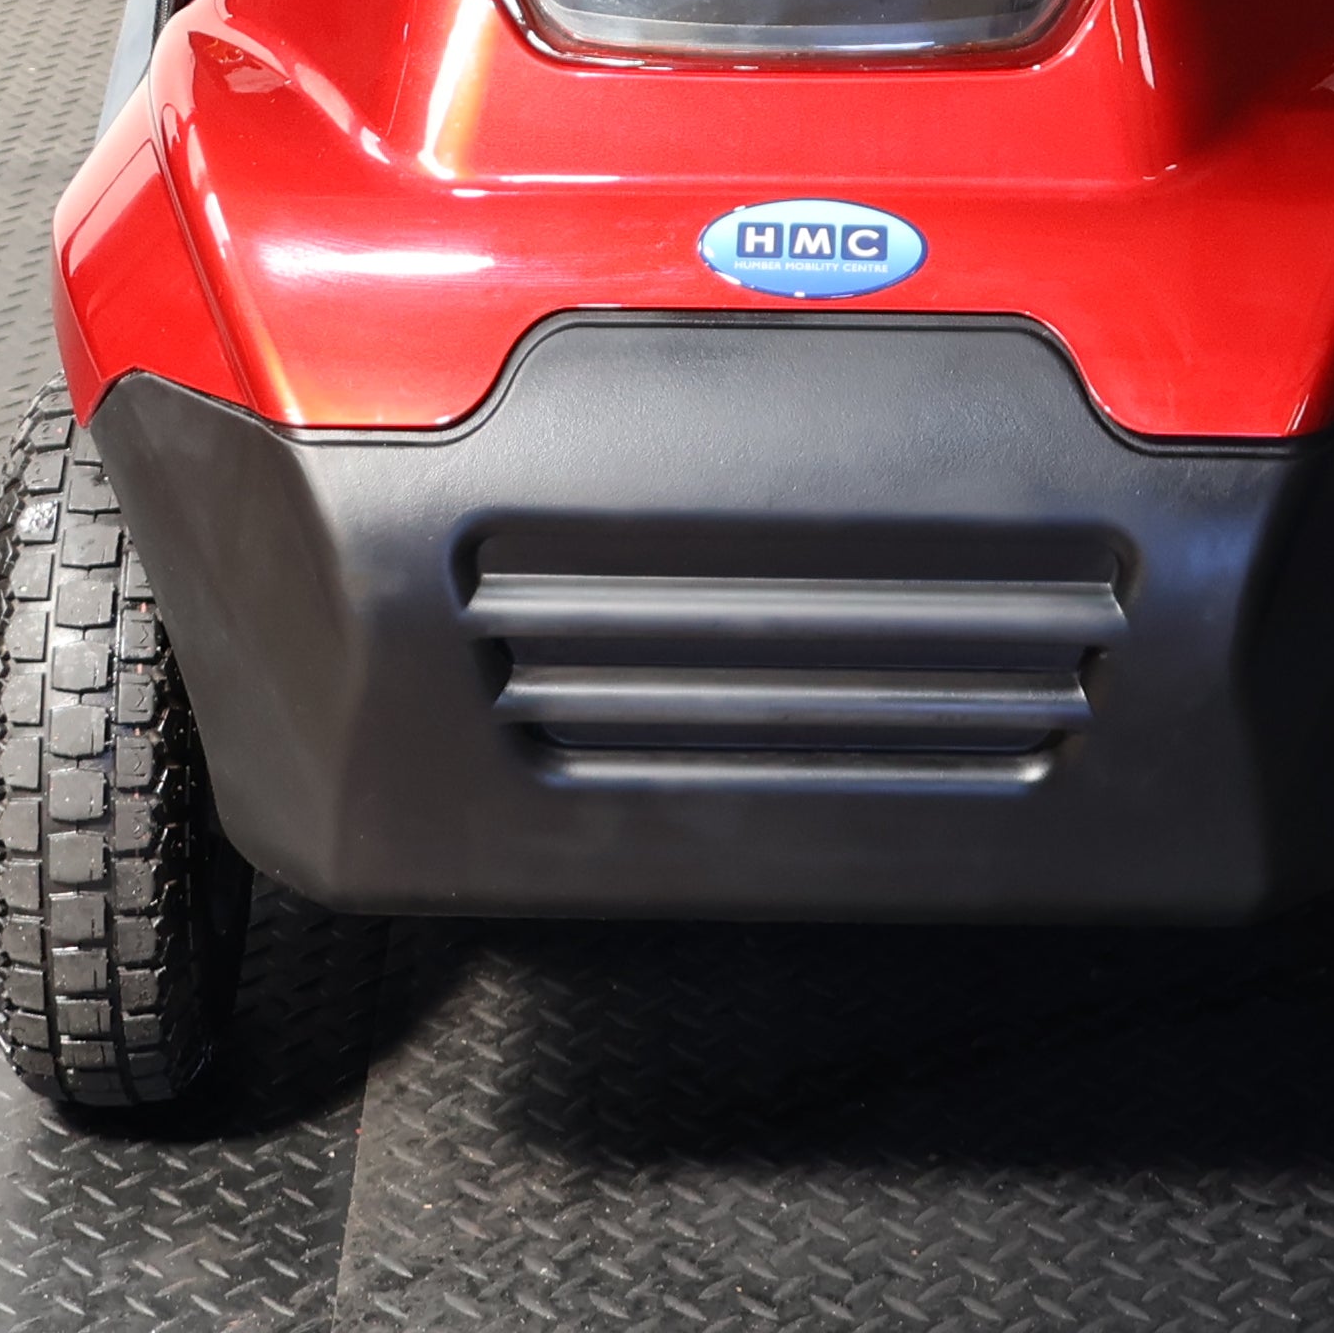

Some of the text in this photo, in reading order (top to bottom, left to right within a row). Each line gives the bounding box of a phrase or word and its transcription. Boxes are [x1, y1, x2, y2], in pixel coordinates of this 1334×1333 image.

[744, 226, 880, 257] HMC
[734, 260, 889, 273] HUMBER MOBILITY CENTRE
